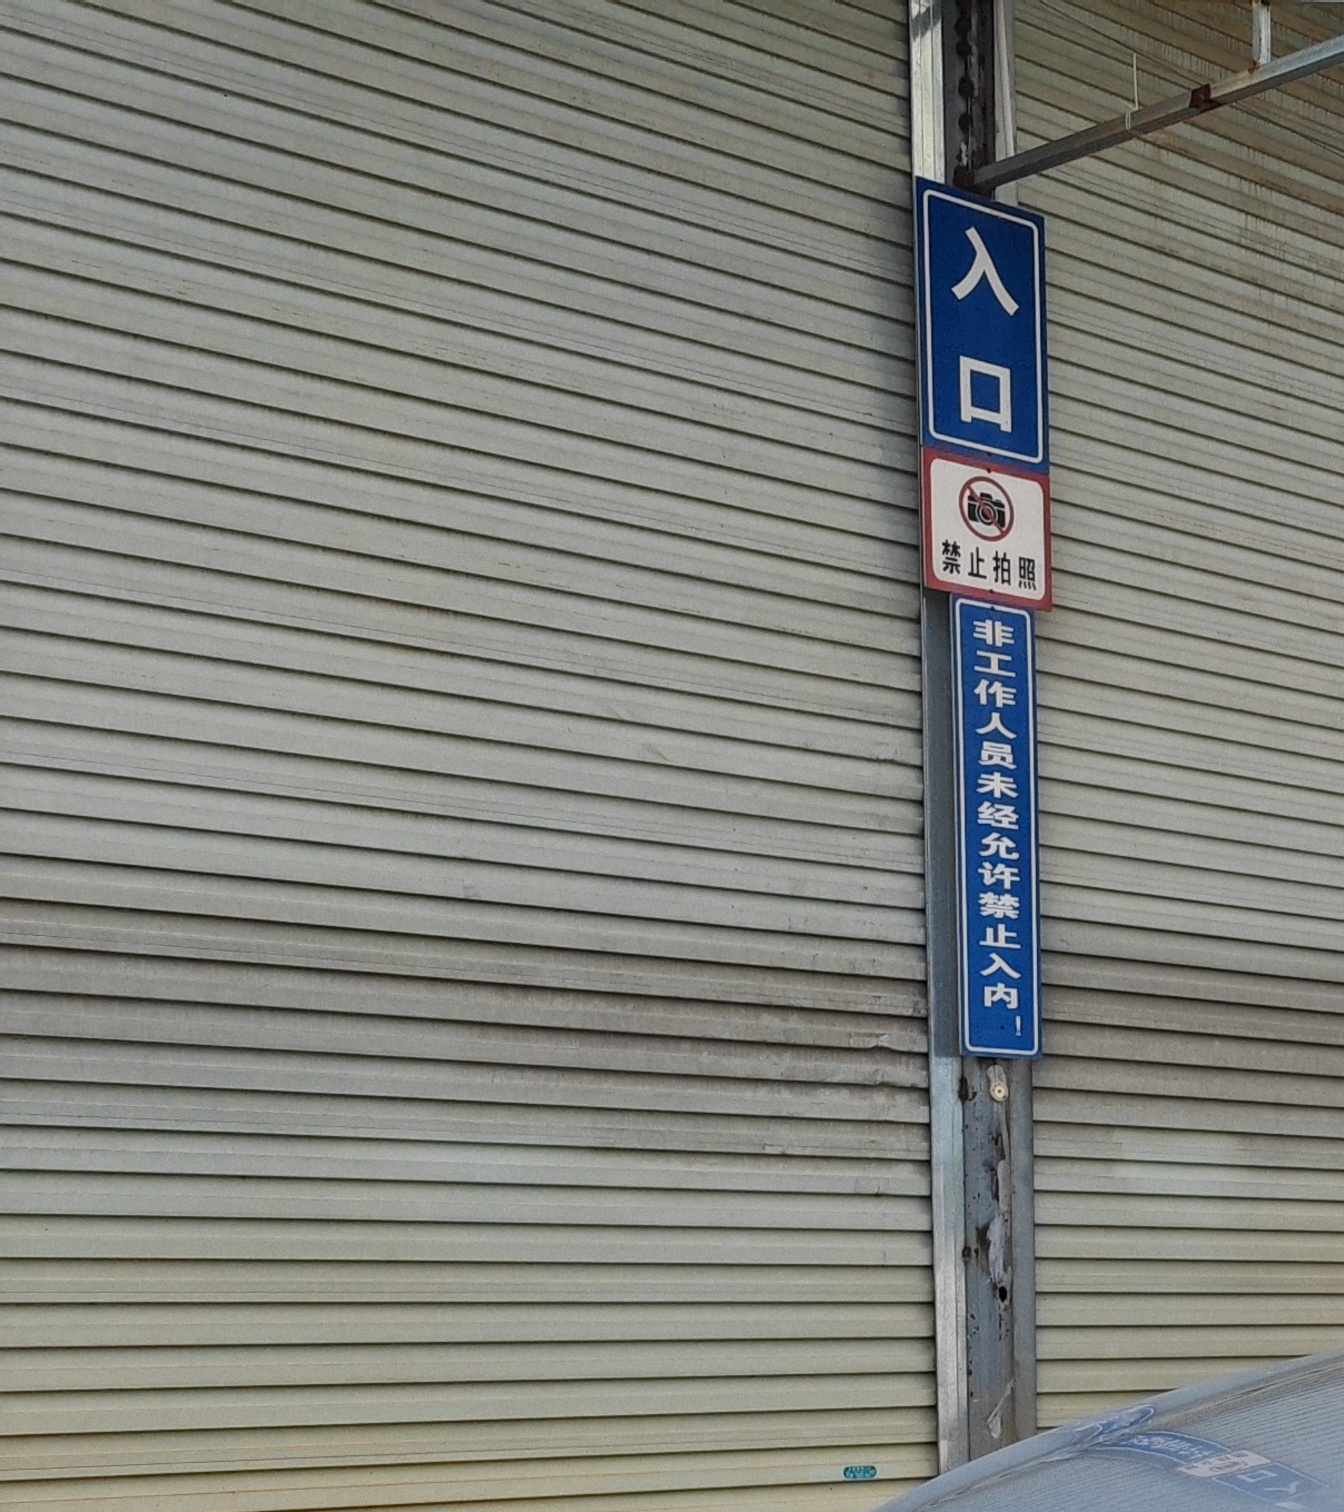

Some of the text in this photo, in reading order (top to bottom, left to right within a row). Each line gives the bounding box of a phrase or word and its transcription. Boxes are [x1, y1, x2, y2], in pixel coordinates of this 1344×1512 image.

[951, 227, 1019, 432] 入口
[942, 540, 1037, 590] 禁止拍照
[973, 619, 1021, 1036] 非工作人员未经允许禁止入内！
